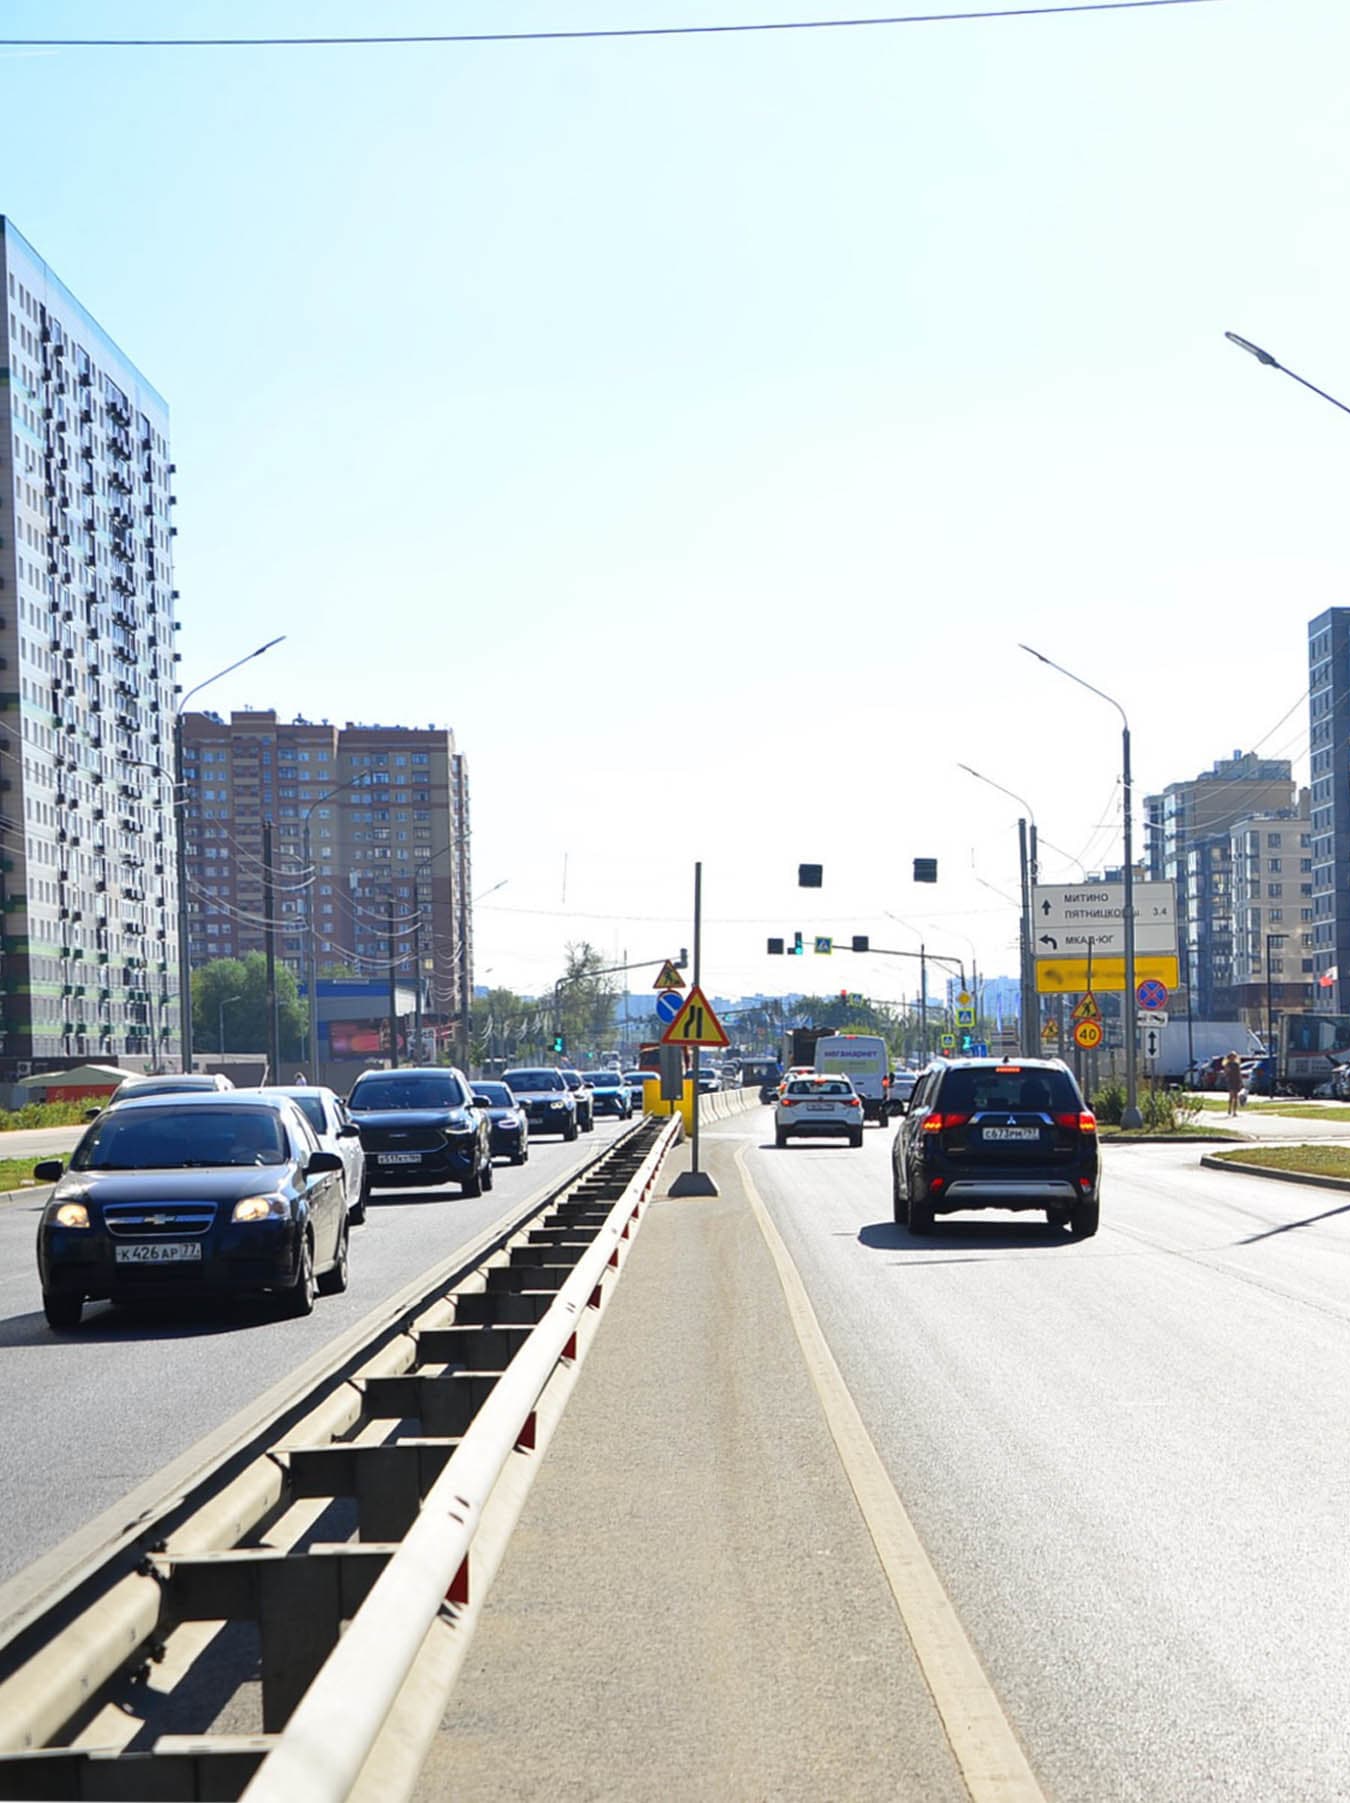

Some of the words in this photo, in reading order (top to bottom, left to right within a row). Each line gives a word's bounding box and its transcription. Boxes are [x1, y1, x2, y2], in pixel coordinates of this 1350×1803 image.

[1064, 893, 1109, 902] МИТИНО
[1152, 907, 1168, 916] 3.4
[1065, 935, 1115, 945] МКАД-ЮГ
[1079, 1028, 1097, 1040] 40
